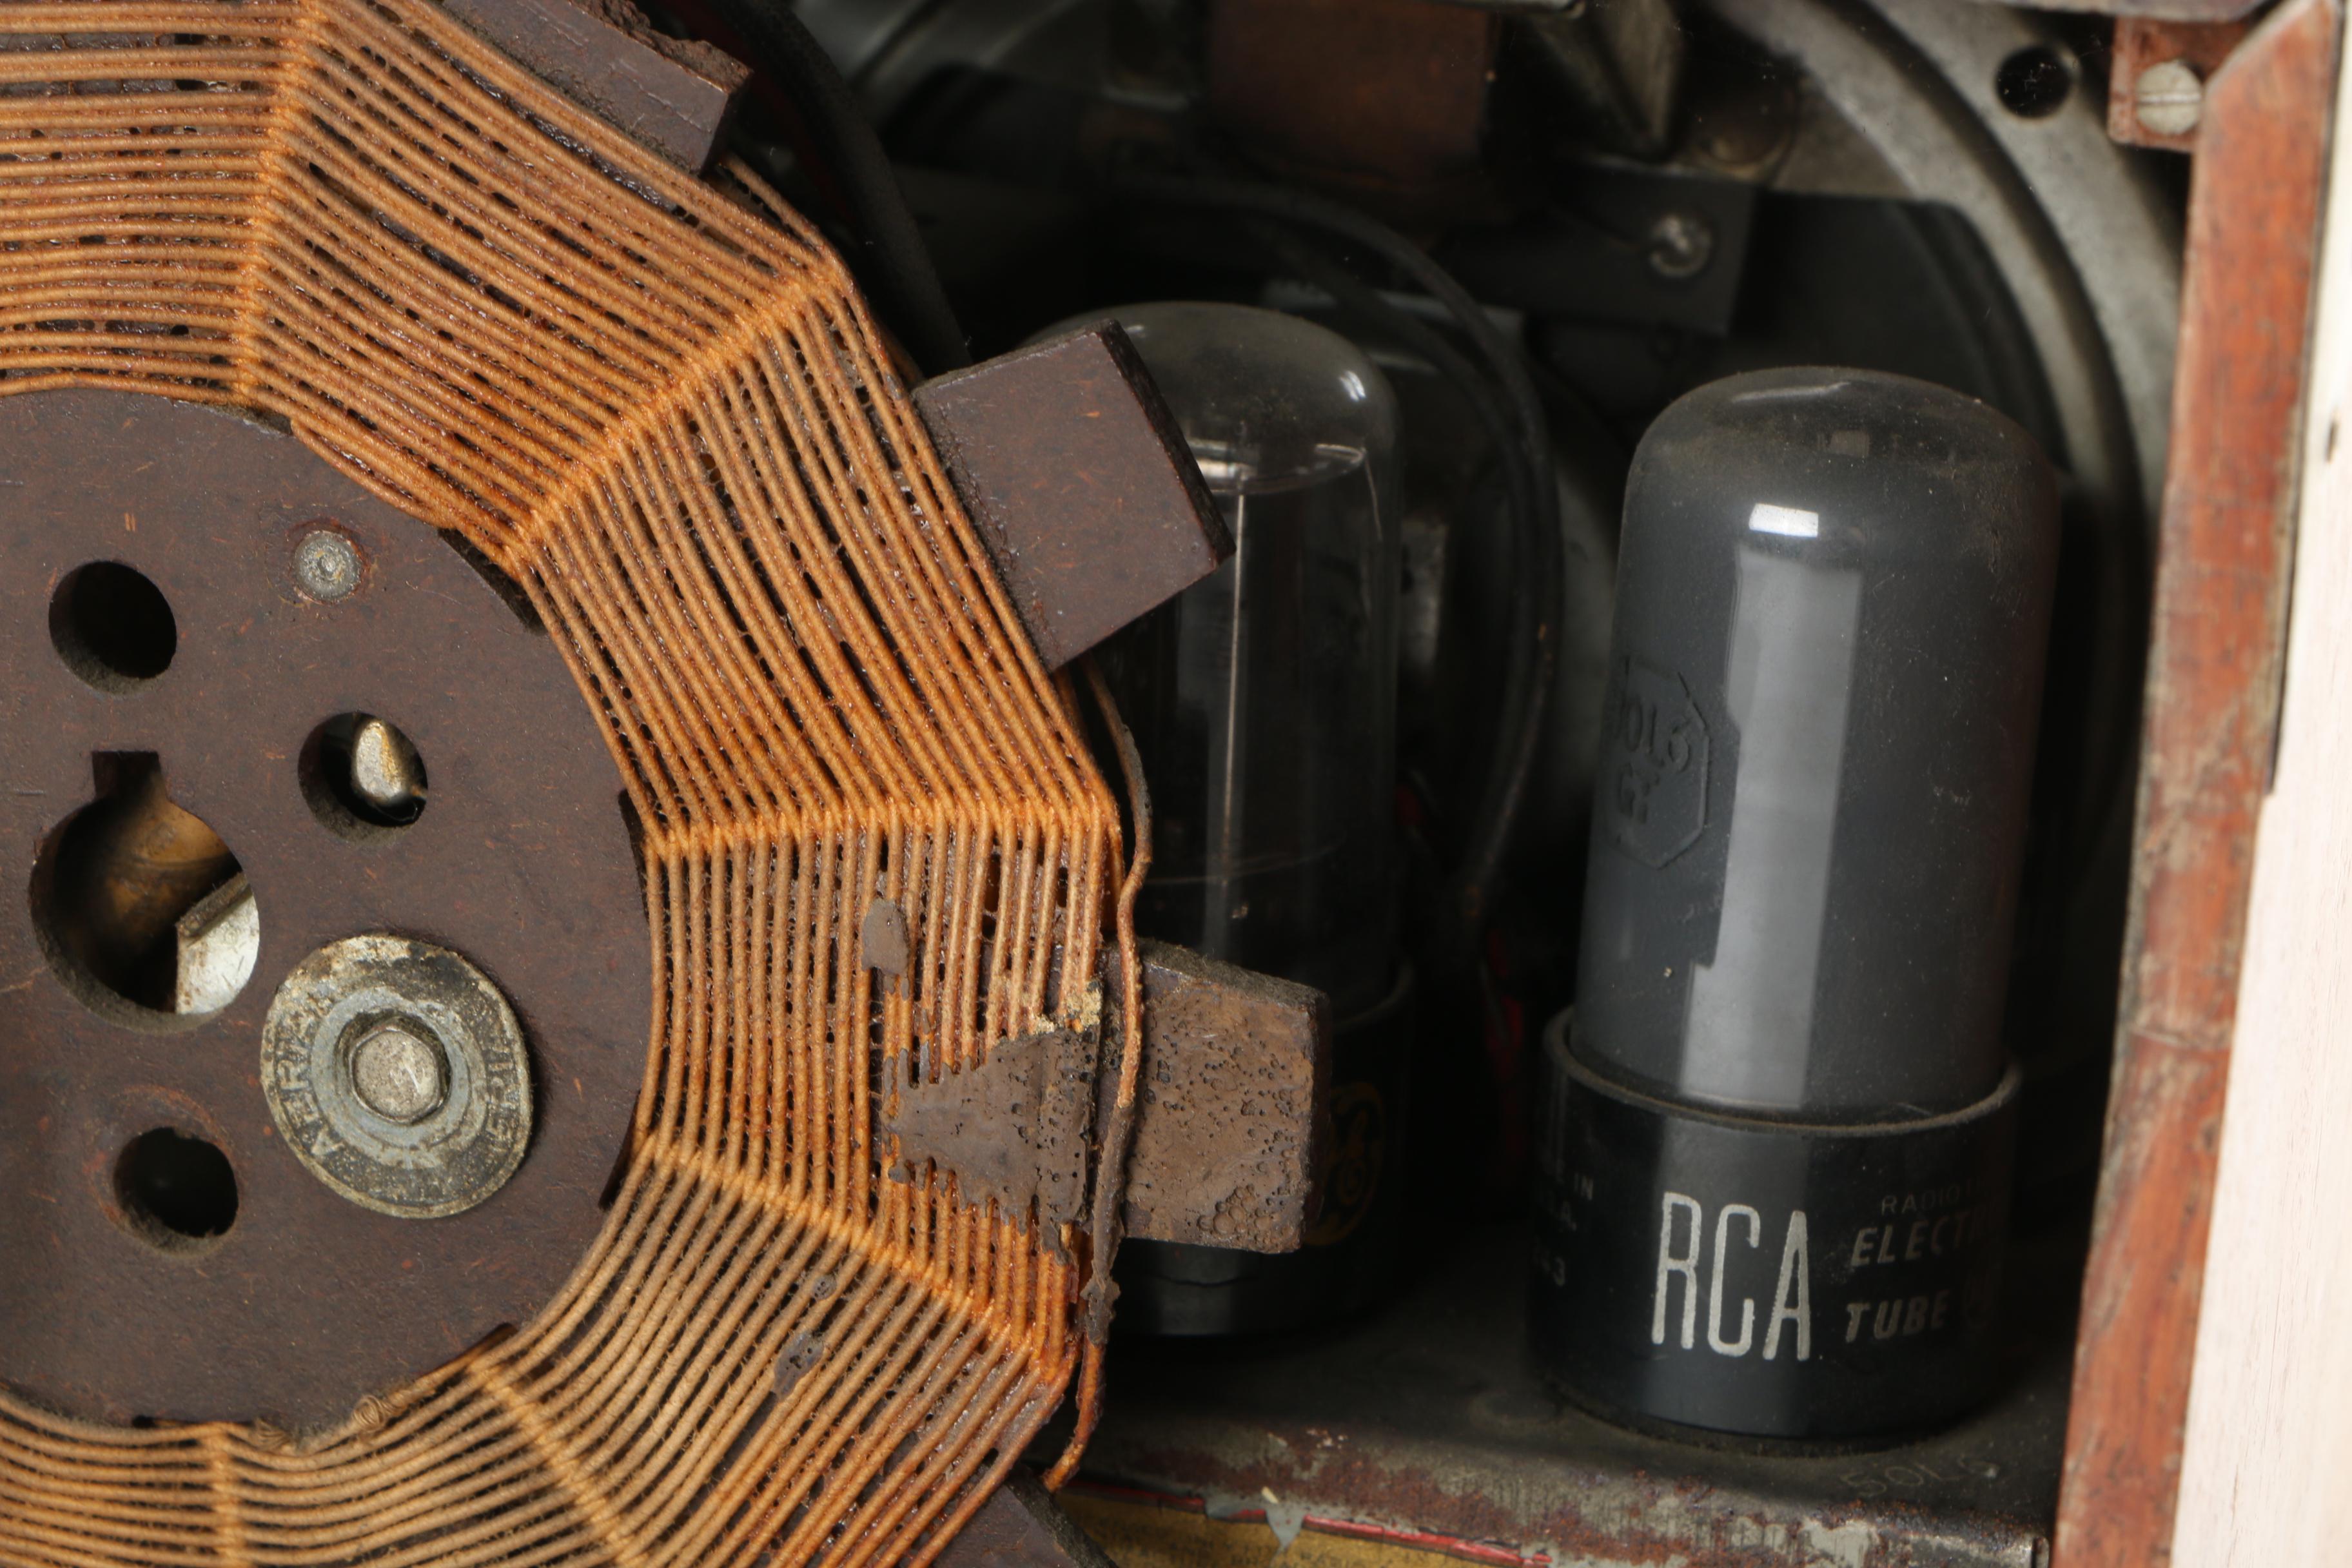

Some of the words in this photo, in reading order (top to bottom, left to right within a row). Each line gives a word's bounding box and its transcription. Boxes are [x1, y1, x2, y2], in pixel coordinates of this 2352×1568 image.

[1850, 1204, 1990, 1268] ELECTR
[1651, 1191, 1812, 1362] RCA
[1844, 1289, 1950, 1344] TUBE
